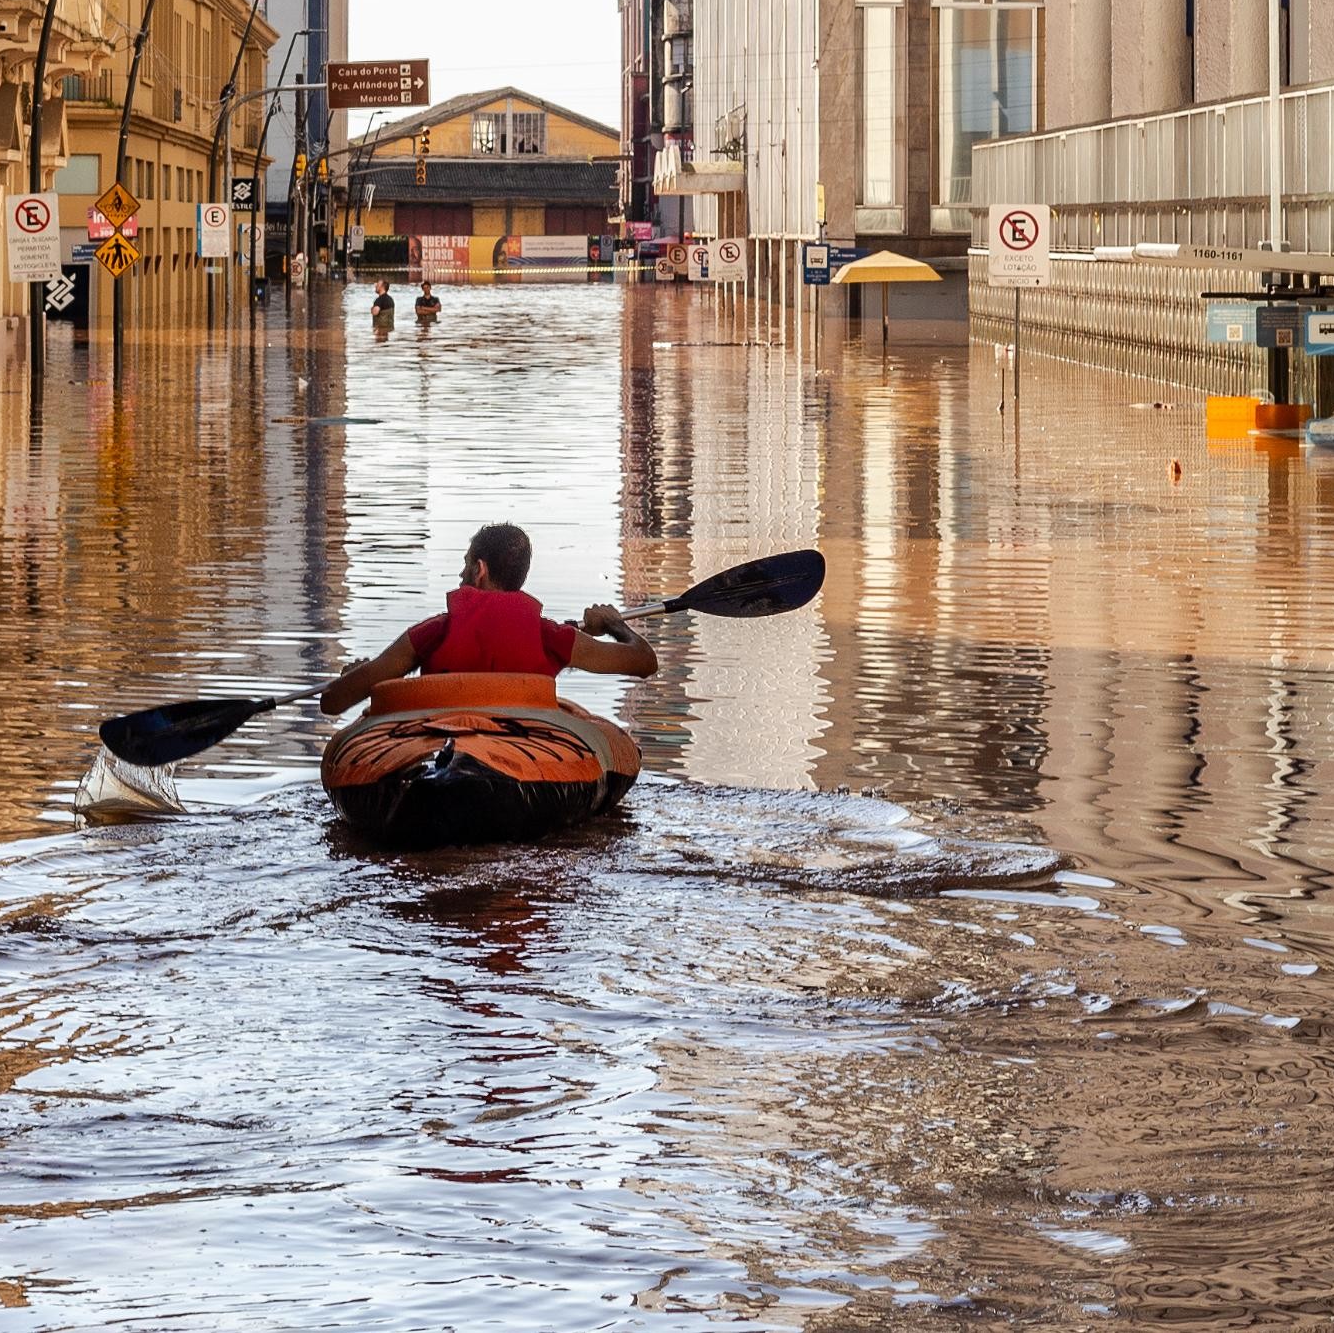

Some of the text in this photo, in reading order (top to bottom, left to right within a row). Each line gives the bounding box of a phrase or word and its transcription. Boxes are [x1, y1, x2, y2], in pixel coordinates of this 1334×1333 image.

[338, 67, 398, 76] Cais do Porto
[332, 80, 398, 91] Pça. Alfândega
[360, 94, 399, 103] Mercado
[27, 207, 39, 225] E
[211, 211, 219, 223] E
[1012, 219, 1026, 242] E
[422, 236, 469, 247] QUEM FAZ
[422, 248, 453, 260] CURSO
[674, 250, 681, 261] E
[1193, 249, 1243, 261] 1160-1161
[1003, 264, 1037, 272] LOTAÇÃO
